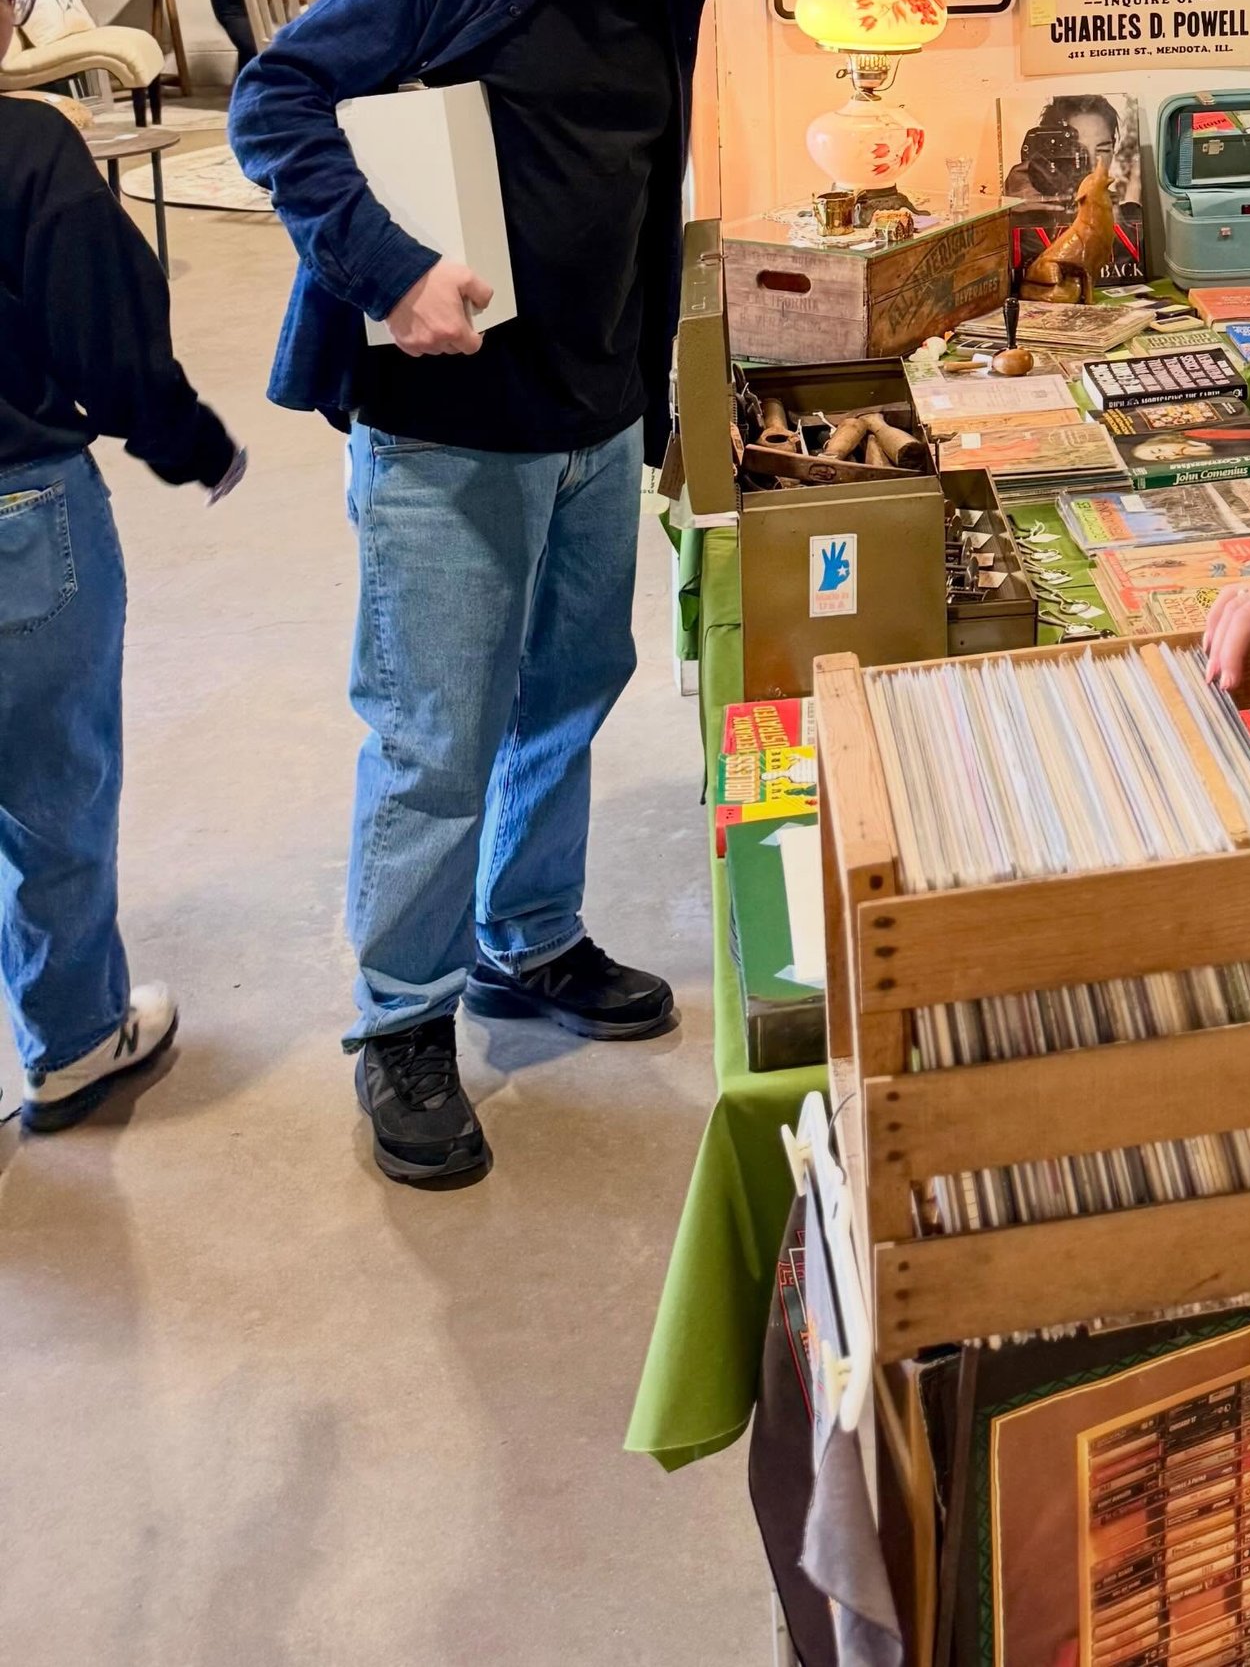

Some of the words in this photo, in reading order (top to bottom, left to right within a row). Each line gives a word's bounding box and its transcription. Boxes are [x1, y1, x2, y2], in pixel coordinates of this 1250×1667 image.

[1050, 13, 1141, 43] CHARLES
[1150, 13, 1165, 39] D.
[1173, 9, 1249, 38] POWELL
[1068, 51, 1085, 60] 411
[1089, 48, 1130, 58] EIGHTH
[1215, 44, 1234, 52] ILL.
[1100, 262, 1144, 278] BACK
[1172, 472, 1199, 485] John
[1200, 466, 1248, 479] Comenius
[753, 706, 790, 750] USTRATED
[725, 754, 759, 803] JOBLESS
[771, 752, 782, 800] FUTURE
